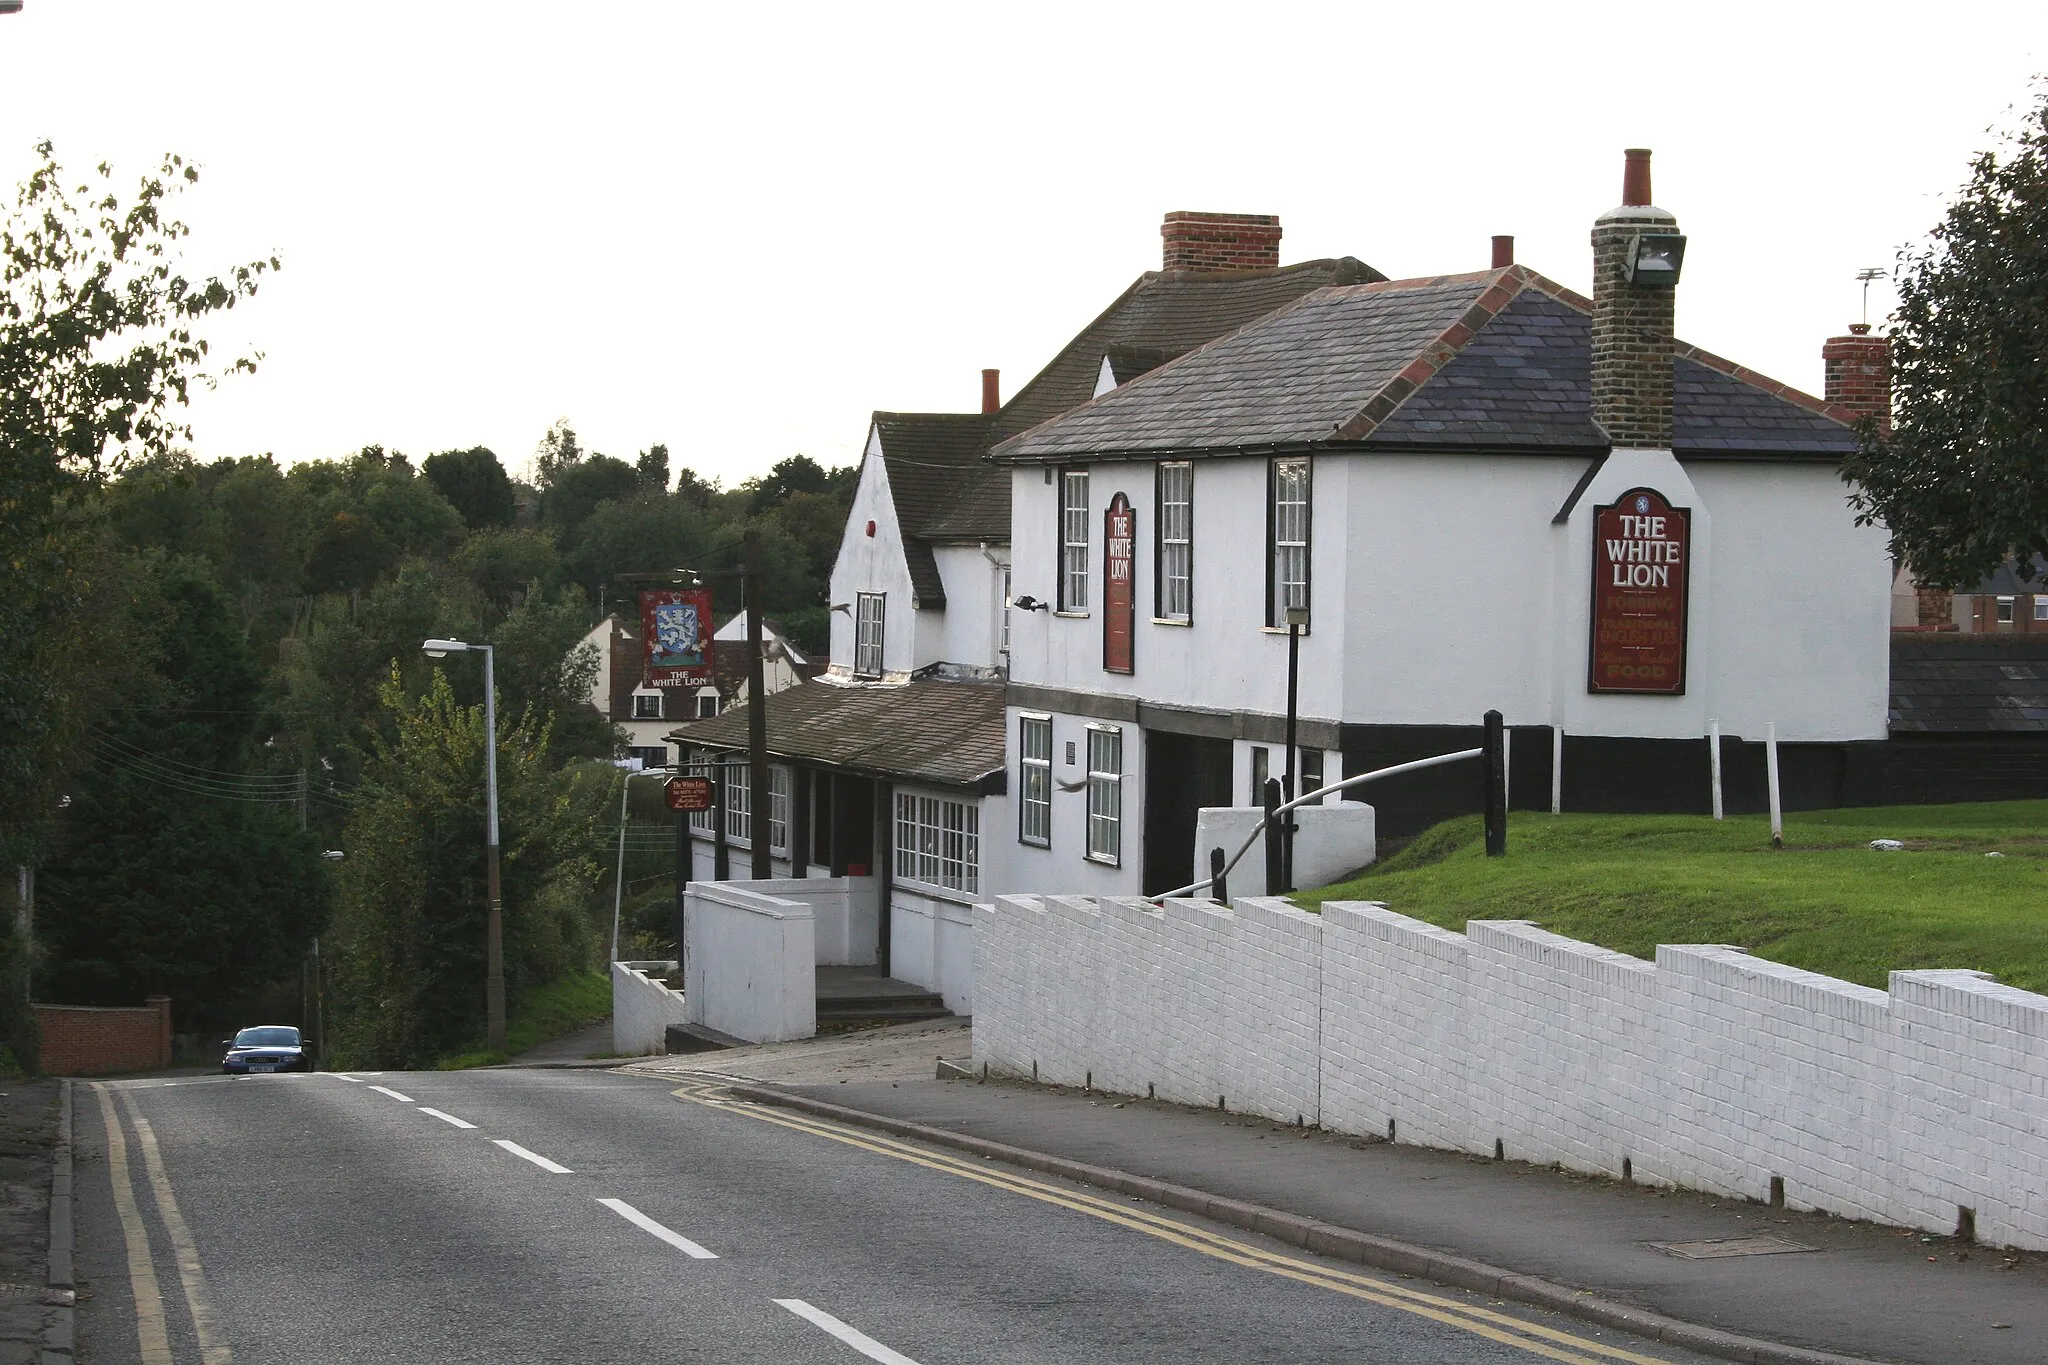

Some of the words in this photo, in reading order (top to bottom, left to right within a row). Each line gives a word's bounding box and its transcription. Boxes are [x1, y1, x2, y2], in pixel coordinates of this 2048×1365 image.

[1113, 517, 1128, 538] THE
[1619, 515, 1667, 539] THE
[1109, 538, 1131, 558] WHITE
[1606, 539, 1680, 563] WHITE
[1111, 560, 1128, 580] LION
[1612, 564, 1669, 588] LION
[1600, 618, 1678, 630] TRADITIONAL
[1651, 631, 1677, 644] ALES
[670, 671, 689, 679] THE
[1606, 664, 1667, 679] FOOD
[652, 679, 682, 687] WHITE
[684, 677, 707, 686] LION
